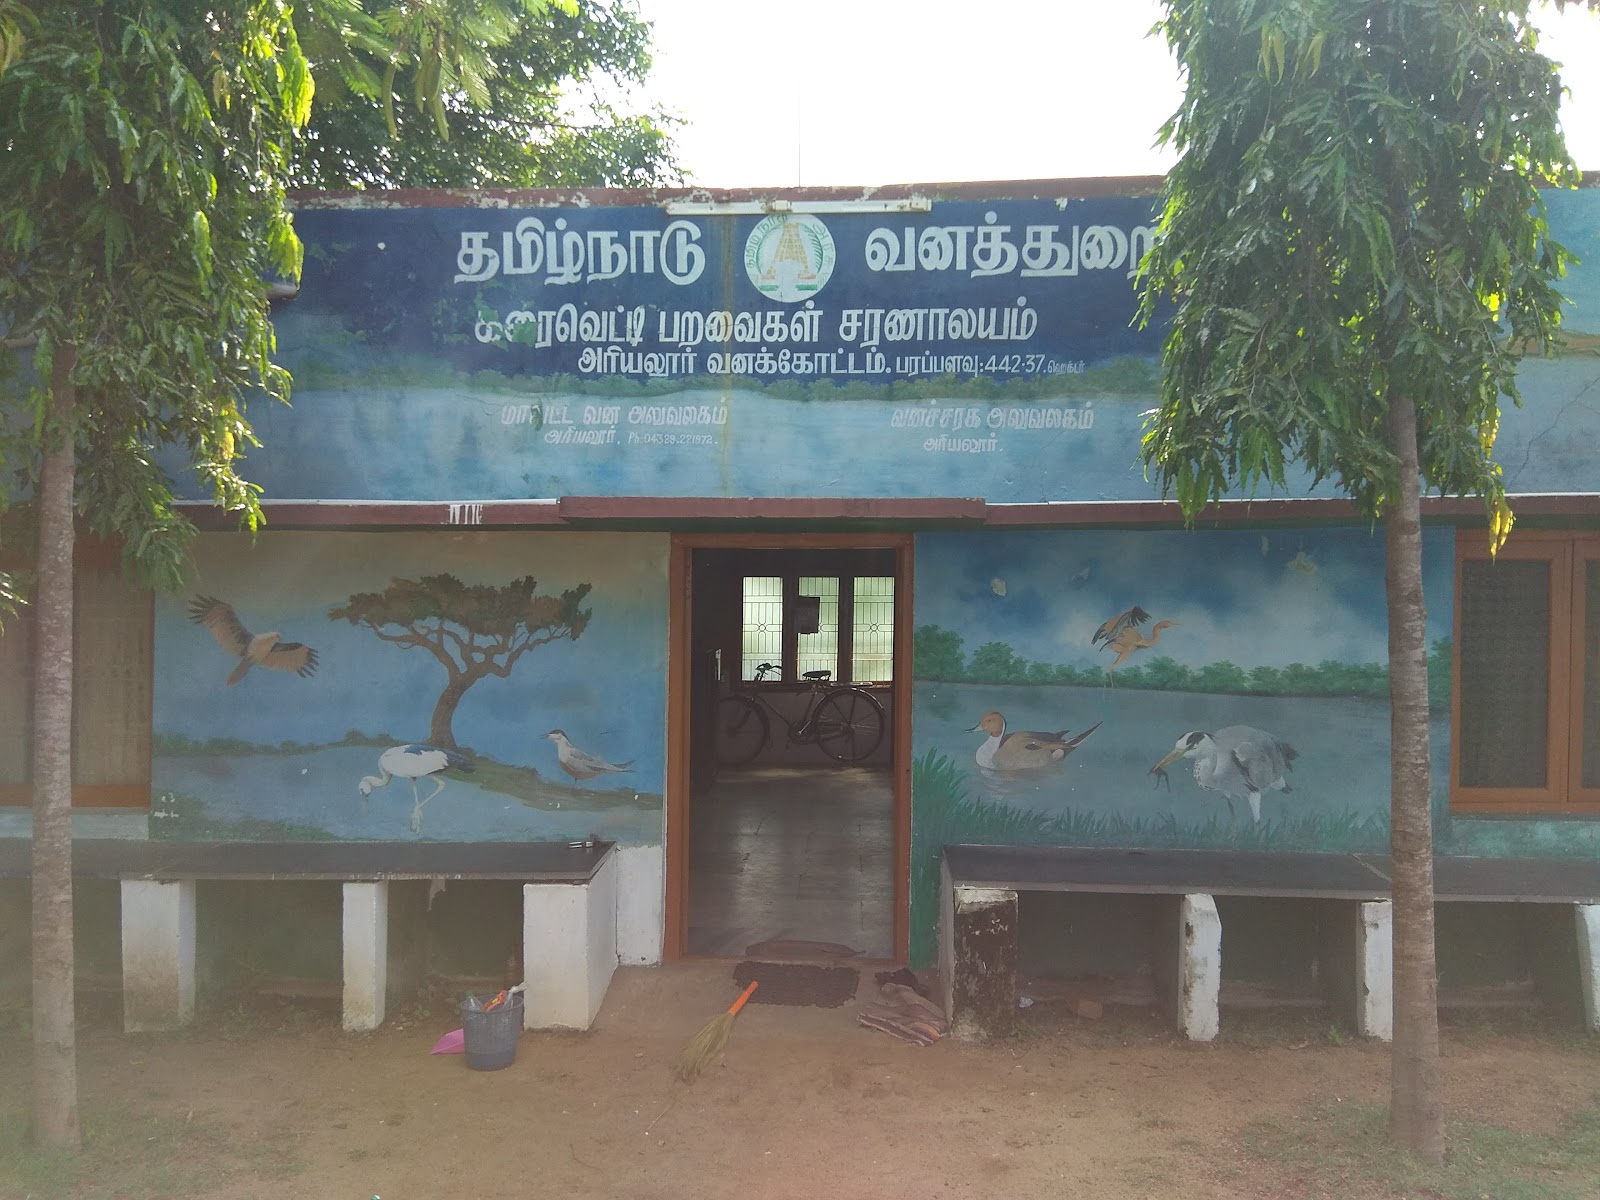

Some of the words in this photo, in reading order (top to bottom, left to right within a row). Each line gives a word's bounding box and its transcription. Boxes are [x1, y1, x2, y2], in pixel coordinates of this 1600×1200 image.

[453, 216, 706, 286] தமிழ்நாடு
[658, 300, 824, 349] பறவைகள்
[838, 296, 1038, 348] சரணாலயம்
[577, 345, 698, 377] அரியலூர்
[582, 405, 621, 425] வன
[627, 396, 728, 426] அலுவலகம்
[890, 399, 981, 432] வனச்சரக
[986, 400, 1095, 430] அலுவலகம்
